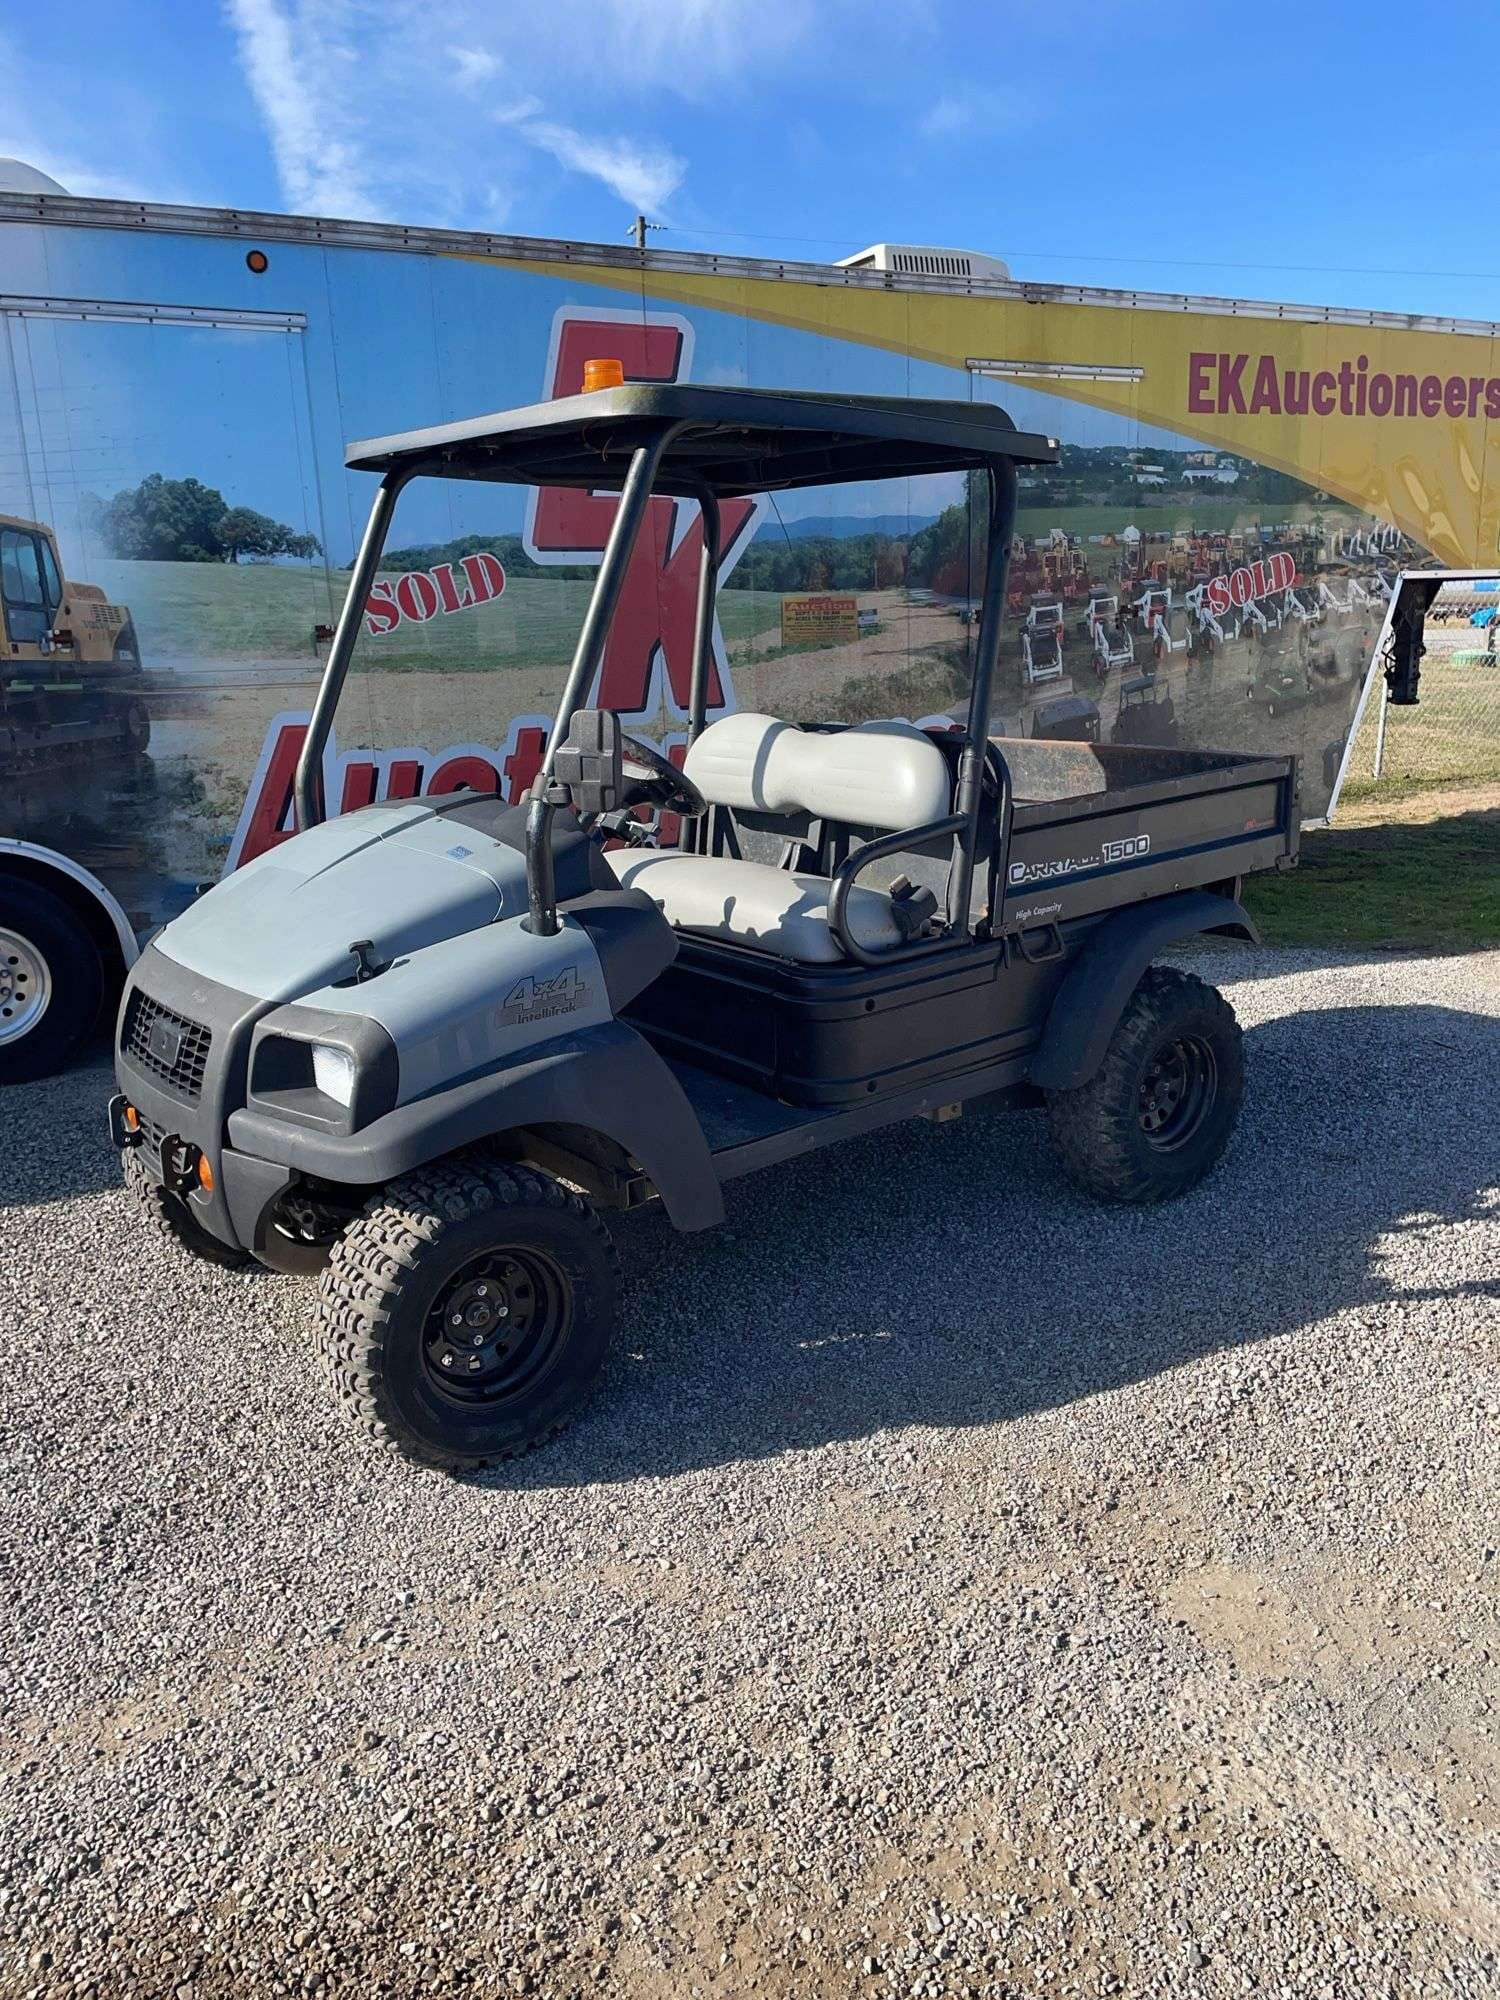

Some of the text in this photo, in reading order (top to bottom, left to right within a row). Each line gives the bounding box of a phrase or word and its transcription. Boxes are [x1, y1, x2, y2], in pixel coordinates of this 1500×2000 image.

[1188, 353, 1500, 418] EKAuctioneers
[365, 553, 506, 636] SOLD
[1208, 552, 1296, 617] SOLD
[1102, 835, 1150, 863] 1500
[1015, 902, 1062, 920] High Capacity
[503, 966, 585, 1010] 4x4
[516, 1002, 577, 1024] IntelliTrak
